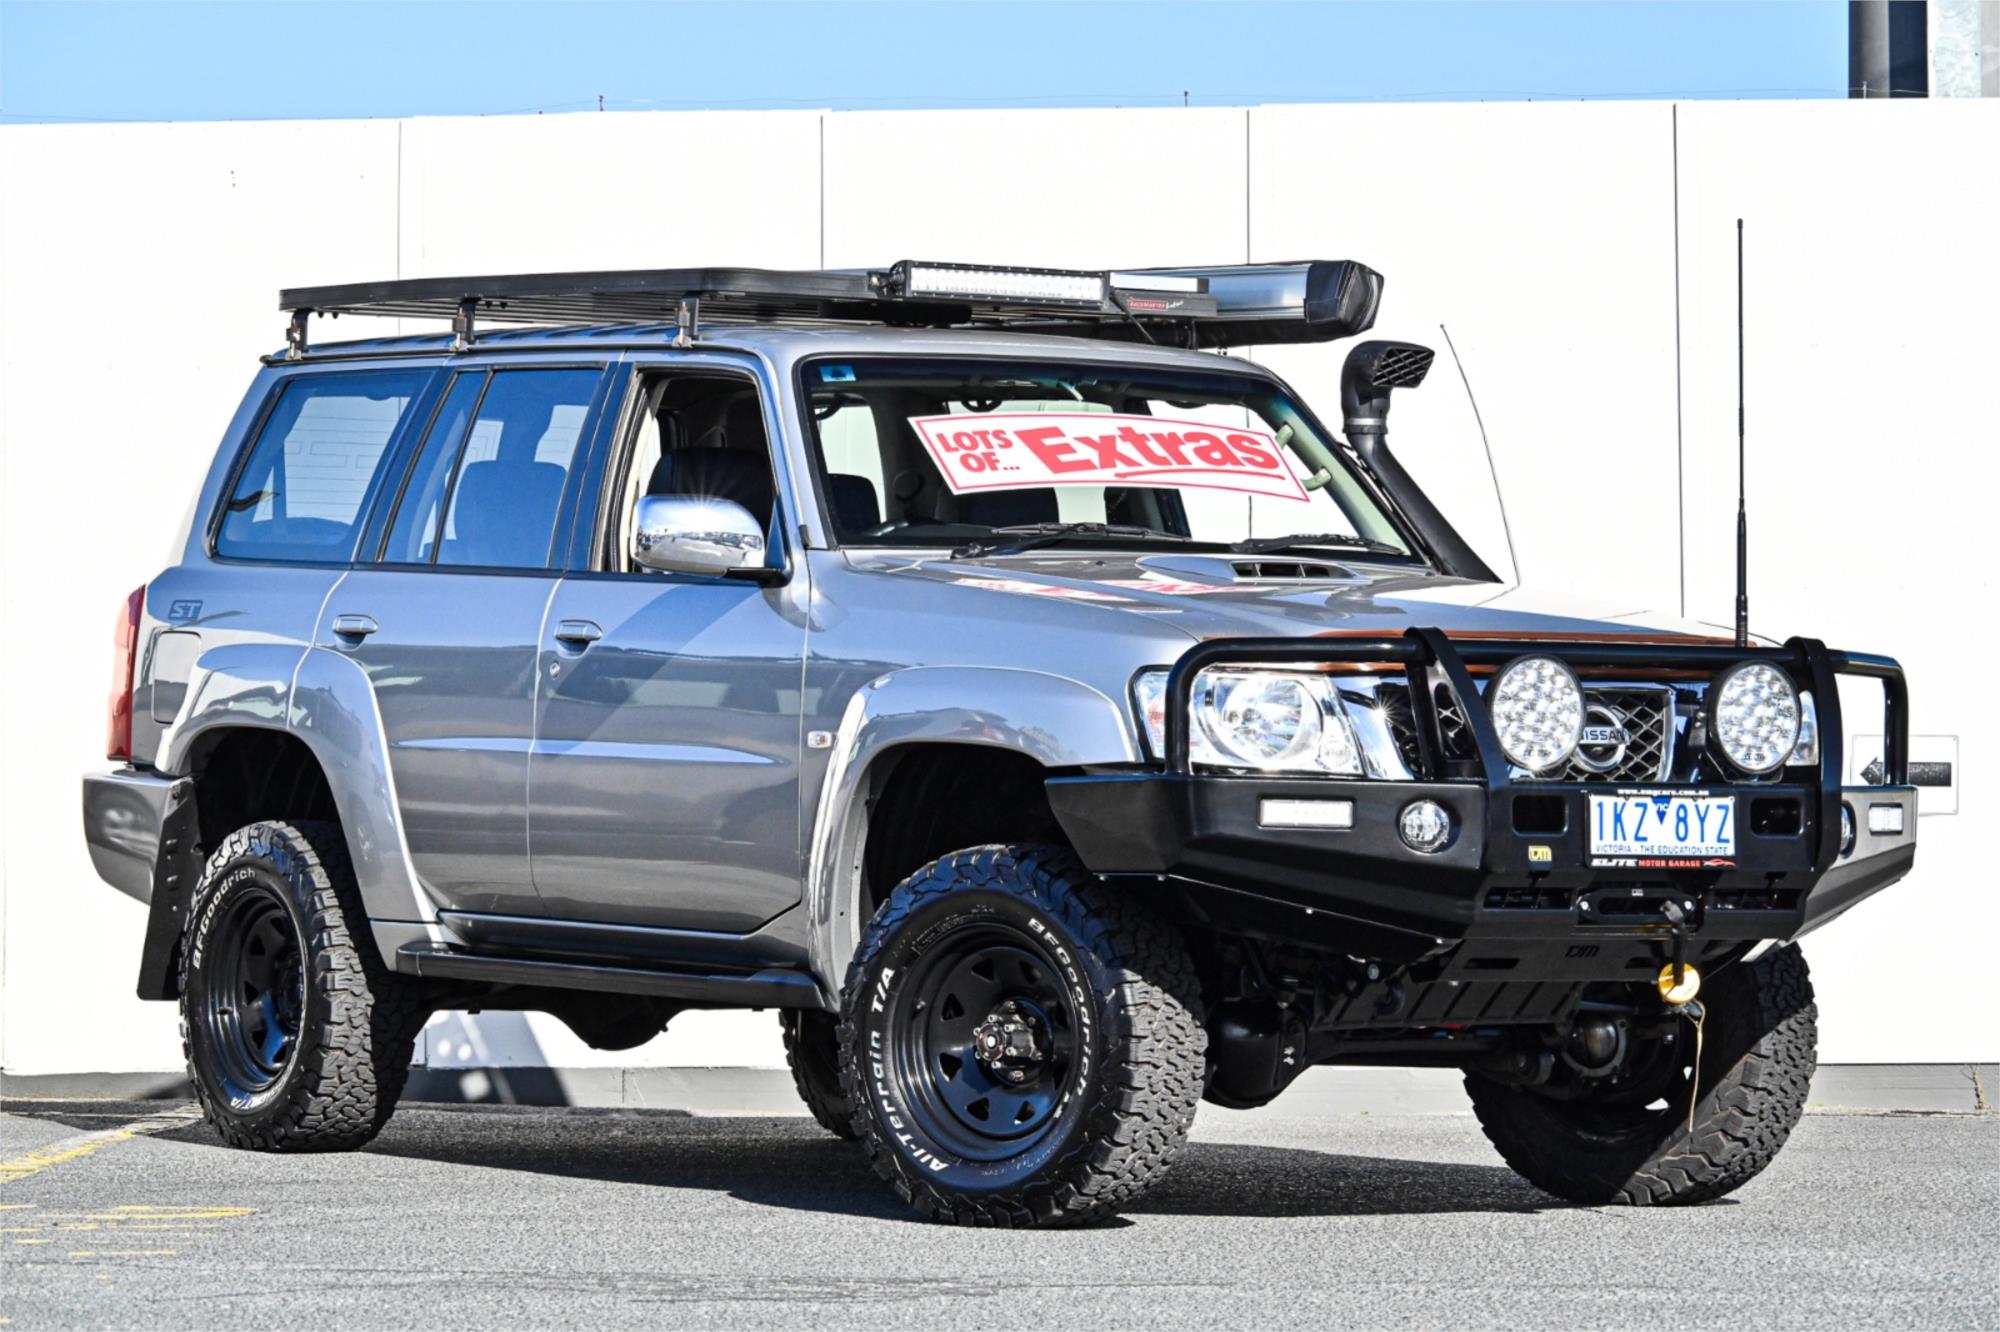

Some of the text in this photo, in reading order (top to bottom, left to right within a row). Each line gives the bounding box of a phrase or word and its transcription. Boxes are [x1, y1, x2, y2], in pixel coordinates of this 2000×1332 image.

[935, 430, 1013, 453] LOTS
[1014, 426, 1280, 474] Extras
[959, 452, 1021, 473] OF...
[169, 600, 203, 619] ST
[1597, 801, 1730, 843] 1KZ 8YZ
[1591, 858, 1701, 868] ELITE MOTOR GARAGE
[1595, 844, 1632, 854] VICTORIA
[1640, 845, 1655, 854] THE
[1657, 845, 1703, 855] EDUCATION
[1705, 846, 1729, 855] STATE
[192, 867, 256, 970] BFGoodrich
[1028, 917, 1092, 1097] BFGoodrich
[870, 967, 949, 1172] All-Terrain T/A
